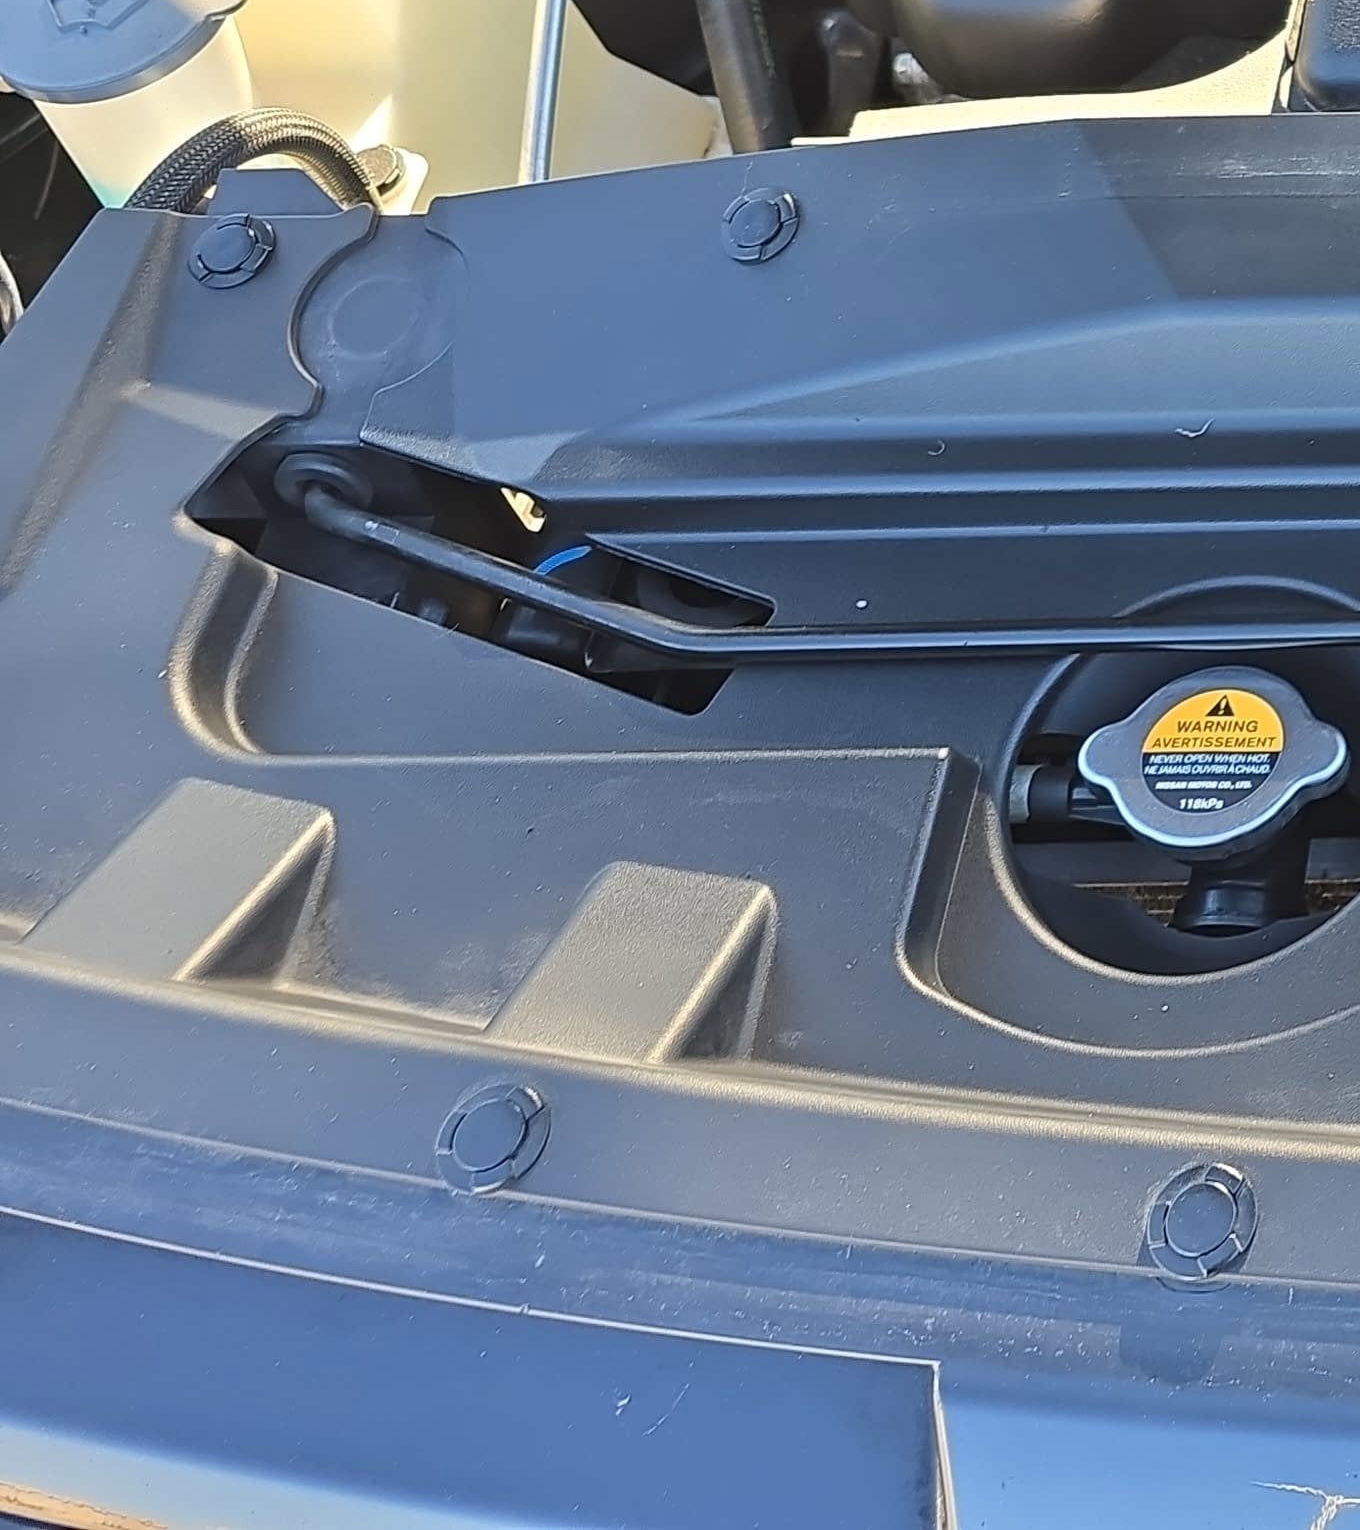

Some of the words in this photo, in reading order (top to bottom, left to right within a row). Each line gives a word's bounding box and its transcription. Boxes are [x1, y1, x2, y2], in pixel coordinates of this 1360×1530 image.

[1177, 720, 1259, 733] WARNING
[1151, 736, 1277, 749] AVERTISSEMENT
[1149, 754, 1183, 764] NEVER
[1184, 754, 1213, 764] OPEN
[1214, 754, 1246, 764] WHEN
[1145, 765, 1159, 775] NE
[1159, 765, 1192, 774] JAMAIS
